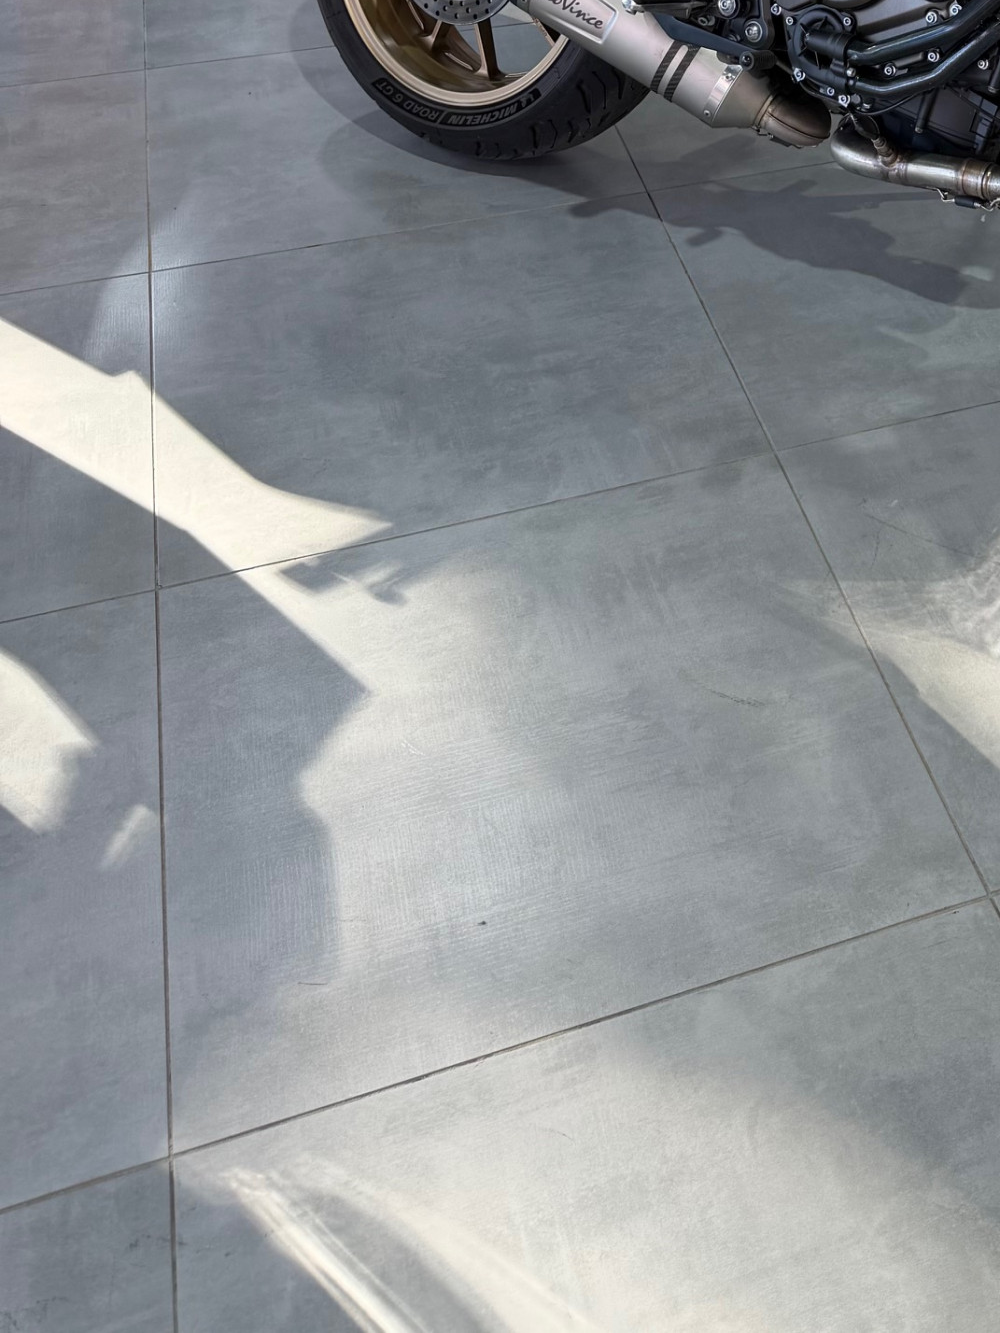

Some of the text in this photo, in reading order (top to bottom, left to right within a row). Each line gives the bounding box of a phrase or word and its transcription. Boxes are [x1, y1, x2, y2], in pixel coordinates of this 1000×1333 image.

[376, 81, 395, 95] GT
[404, 98, 442, 121] ROAD
[447, 105, 518, 126] MICHELIN
